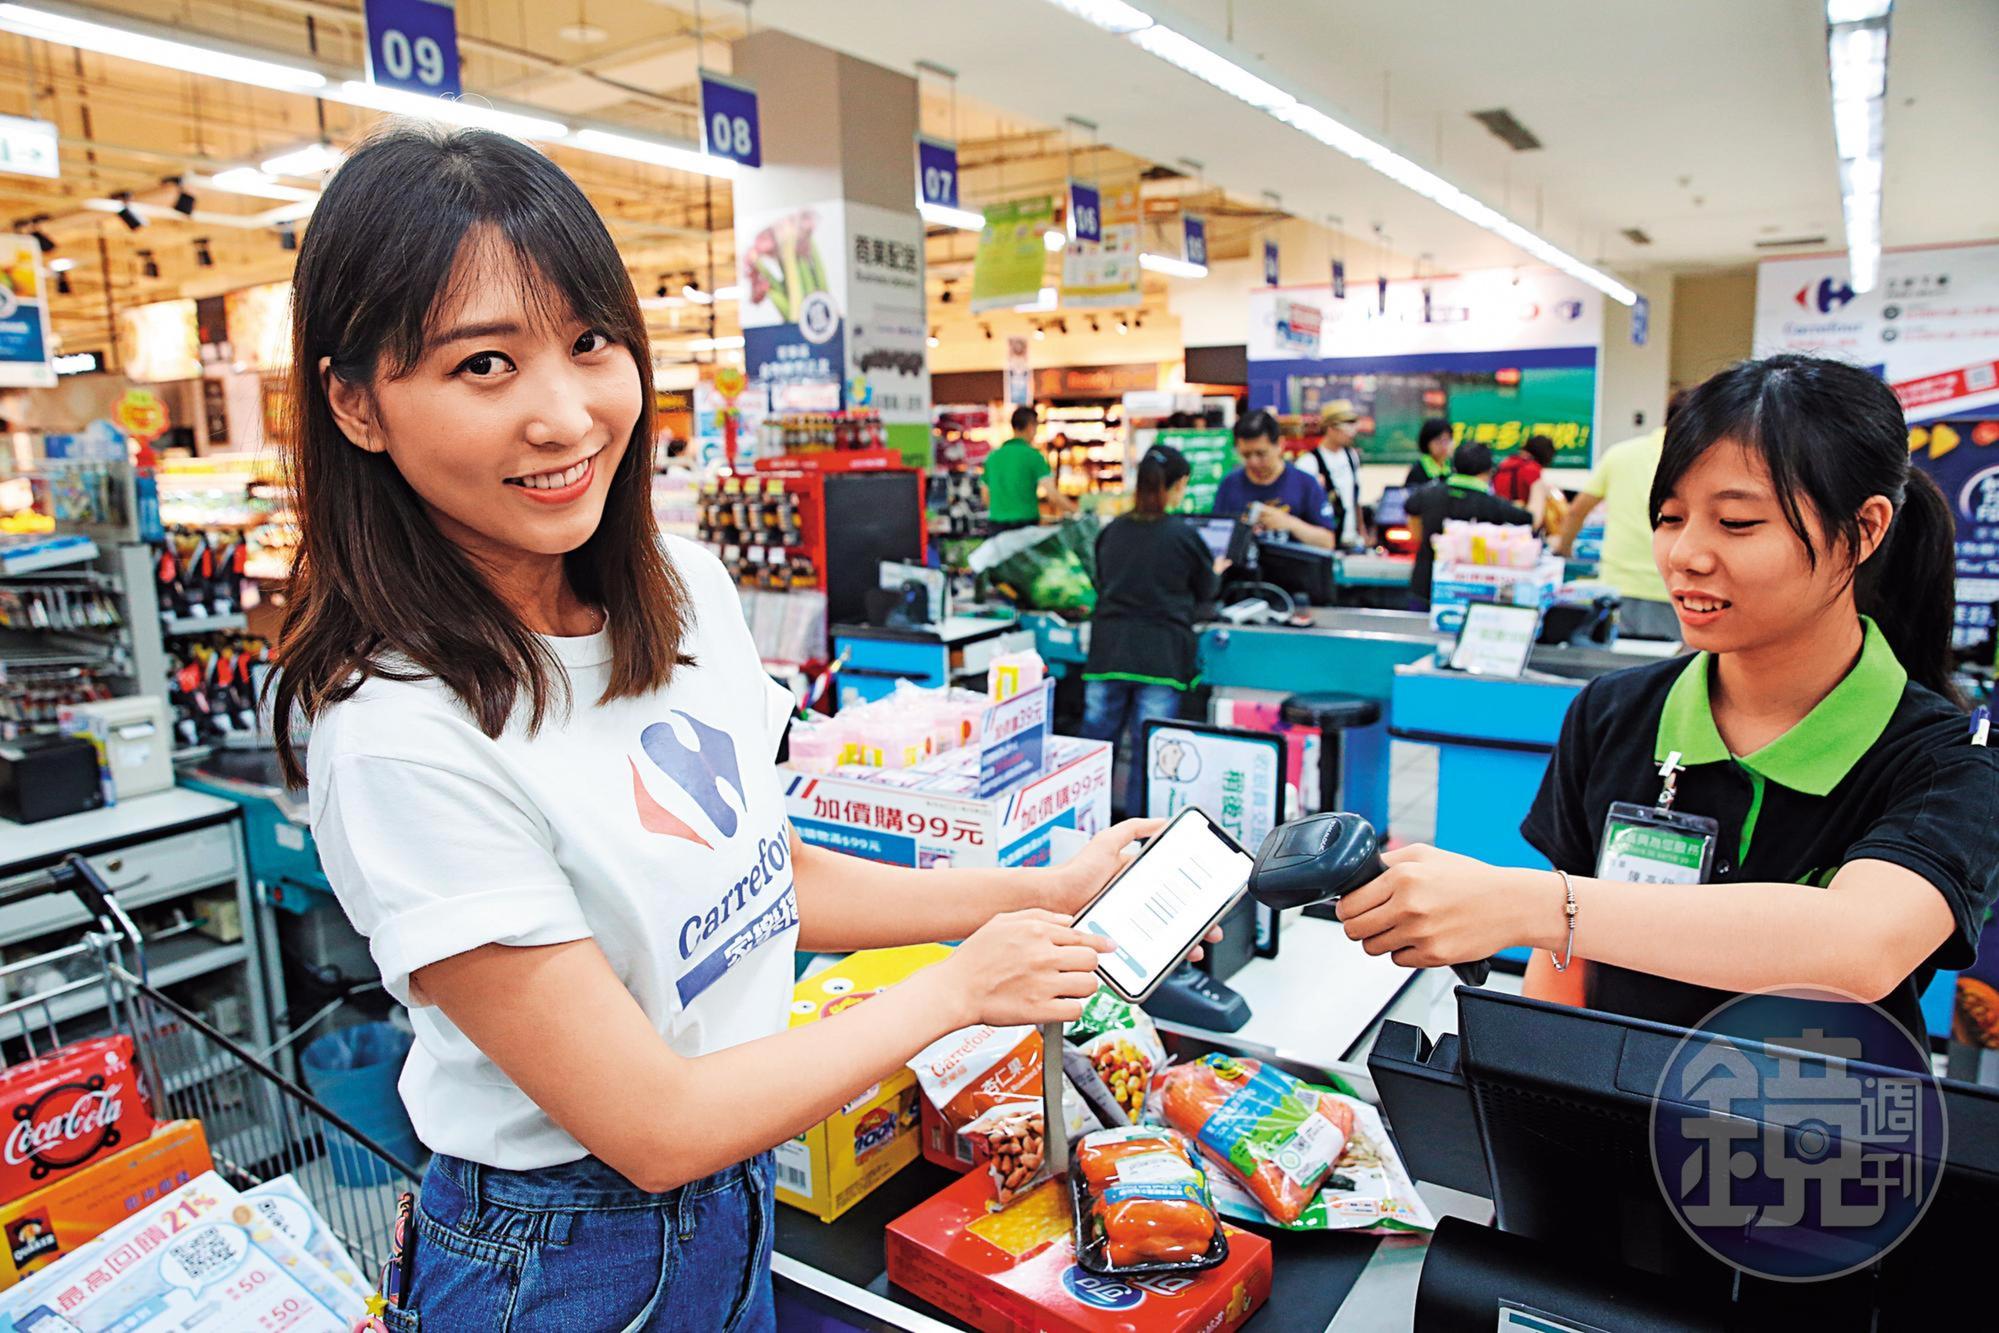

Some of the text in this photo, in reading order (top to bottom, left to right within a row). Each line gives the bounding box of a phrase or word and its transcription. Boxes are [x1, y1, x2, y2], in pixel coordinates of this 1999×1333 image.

[382, 29, 444, 87] 09
[712, 112, 752, 156] 08
[925, 166, 952, 201] 07
[1076, 206, 1097, 235] 06
[814, 795, 984, 846] 加價購99元
[982, 1056, 1026, 1095] 杏仁果
[4, 1082, 123, 1166] Coca-Cola
[57, 1198, 217, 1313] 最高回饋21%
